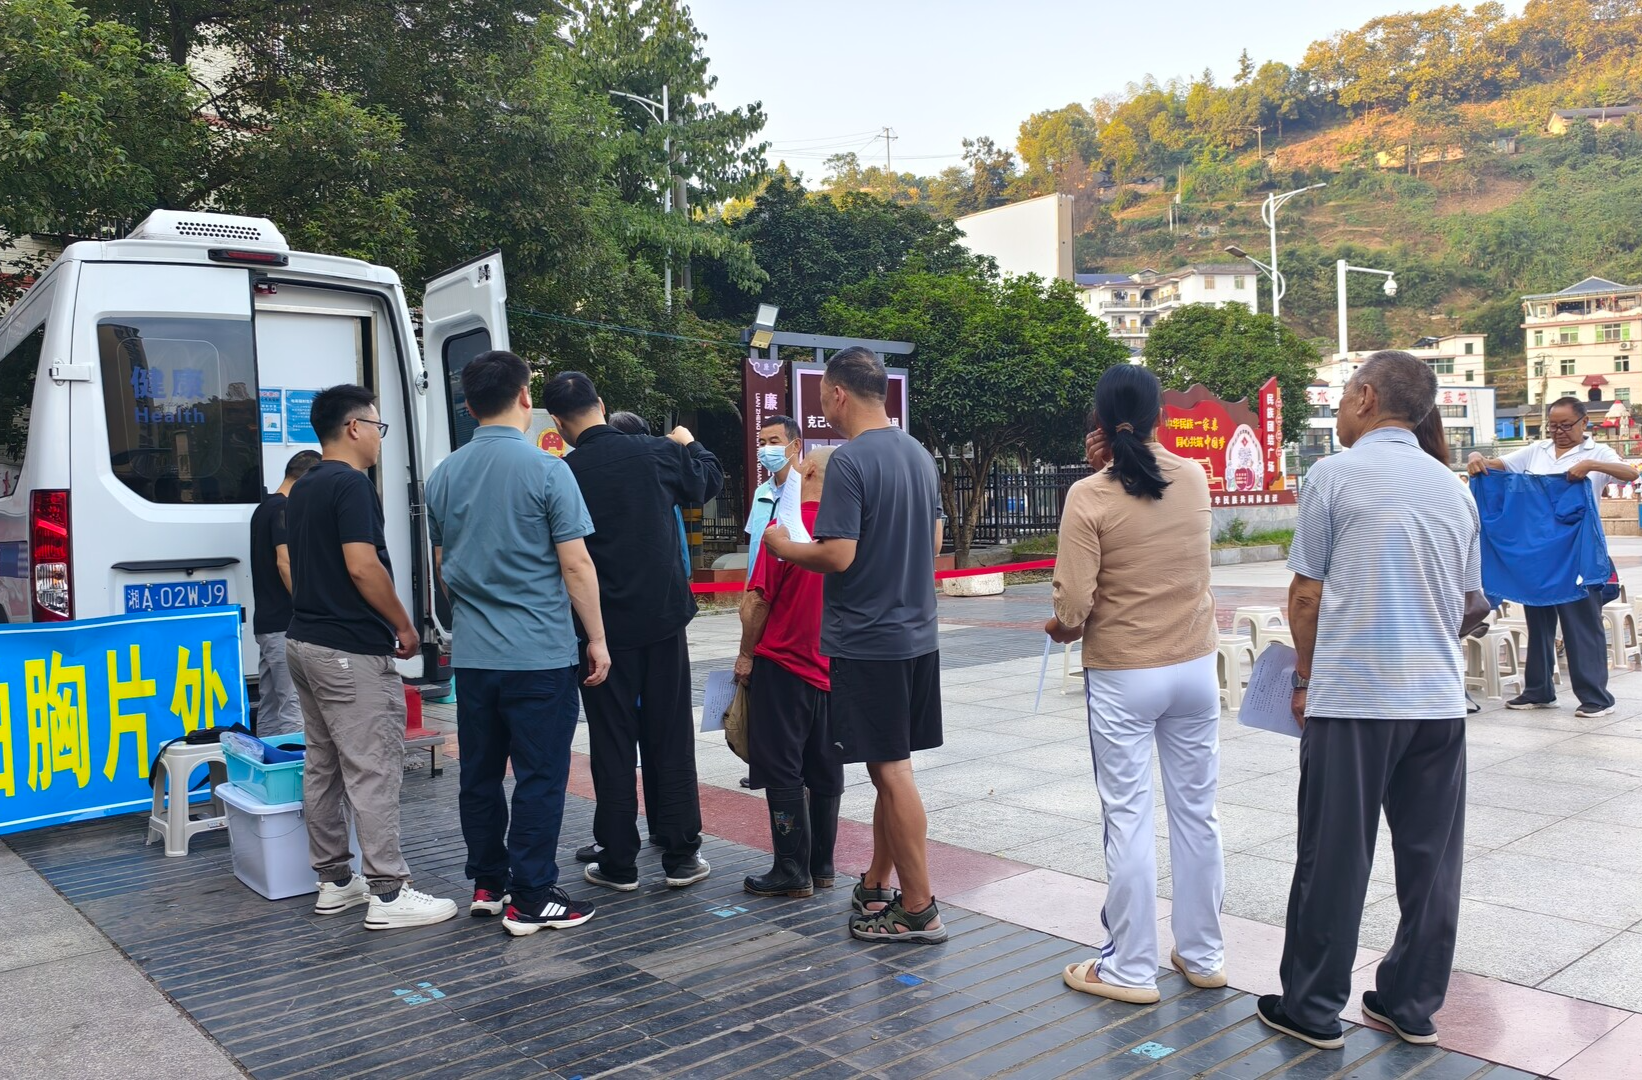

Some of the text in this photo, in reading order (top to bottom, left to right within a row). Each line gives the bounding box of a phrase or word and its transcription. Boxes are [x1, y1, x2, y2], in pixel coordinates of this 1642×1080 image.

[130, 366, 206, 399] 健康
[134, 407, 206, 423] Health
[1266, 393, 1275, 473] 民族团结广场
[1175, 434, 1226, 450] 同心共筑中国梦
[1210, 494, 1278, 505] 华民族共同体意识
